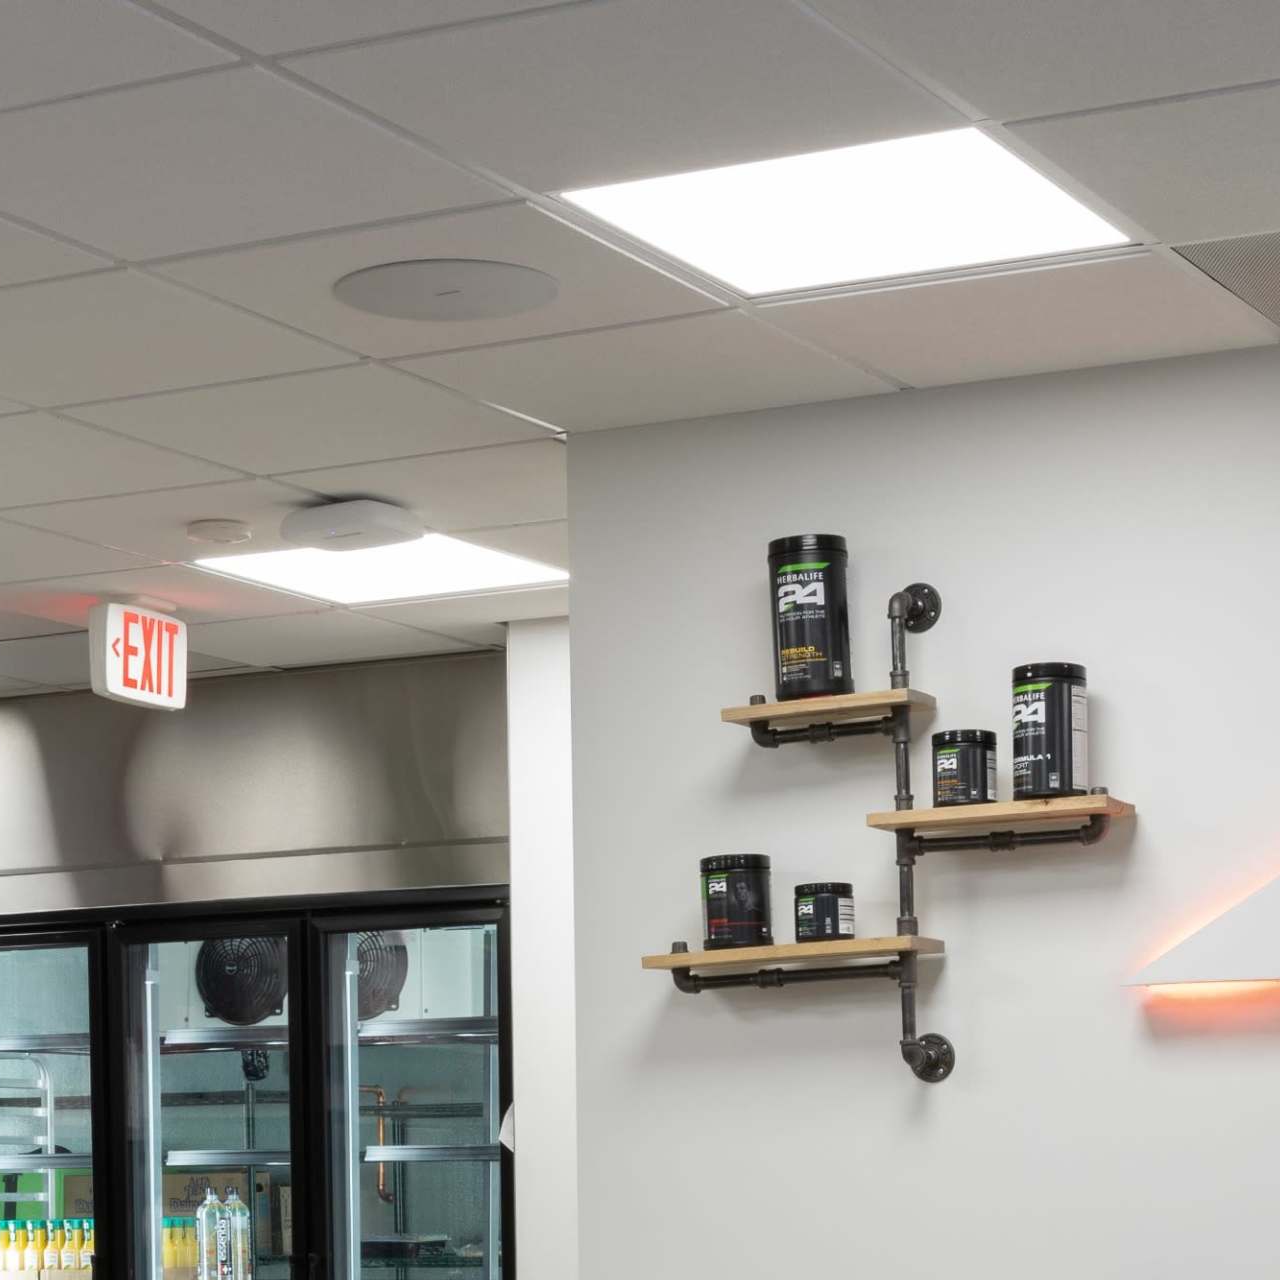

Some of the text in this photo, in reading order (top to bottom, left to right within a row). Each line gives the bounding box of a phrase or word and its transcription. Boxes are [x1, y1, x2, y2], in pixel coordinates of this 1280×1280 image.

[777, 571, 824, 584] HERBALIFE
[778, 581, 825, 613] 24
[123, 611, 179, 698] EXIT
